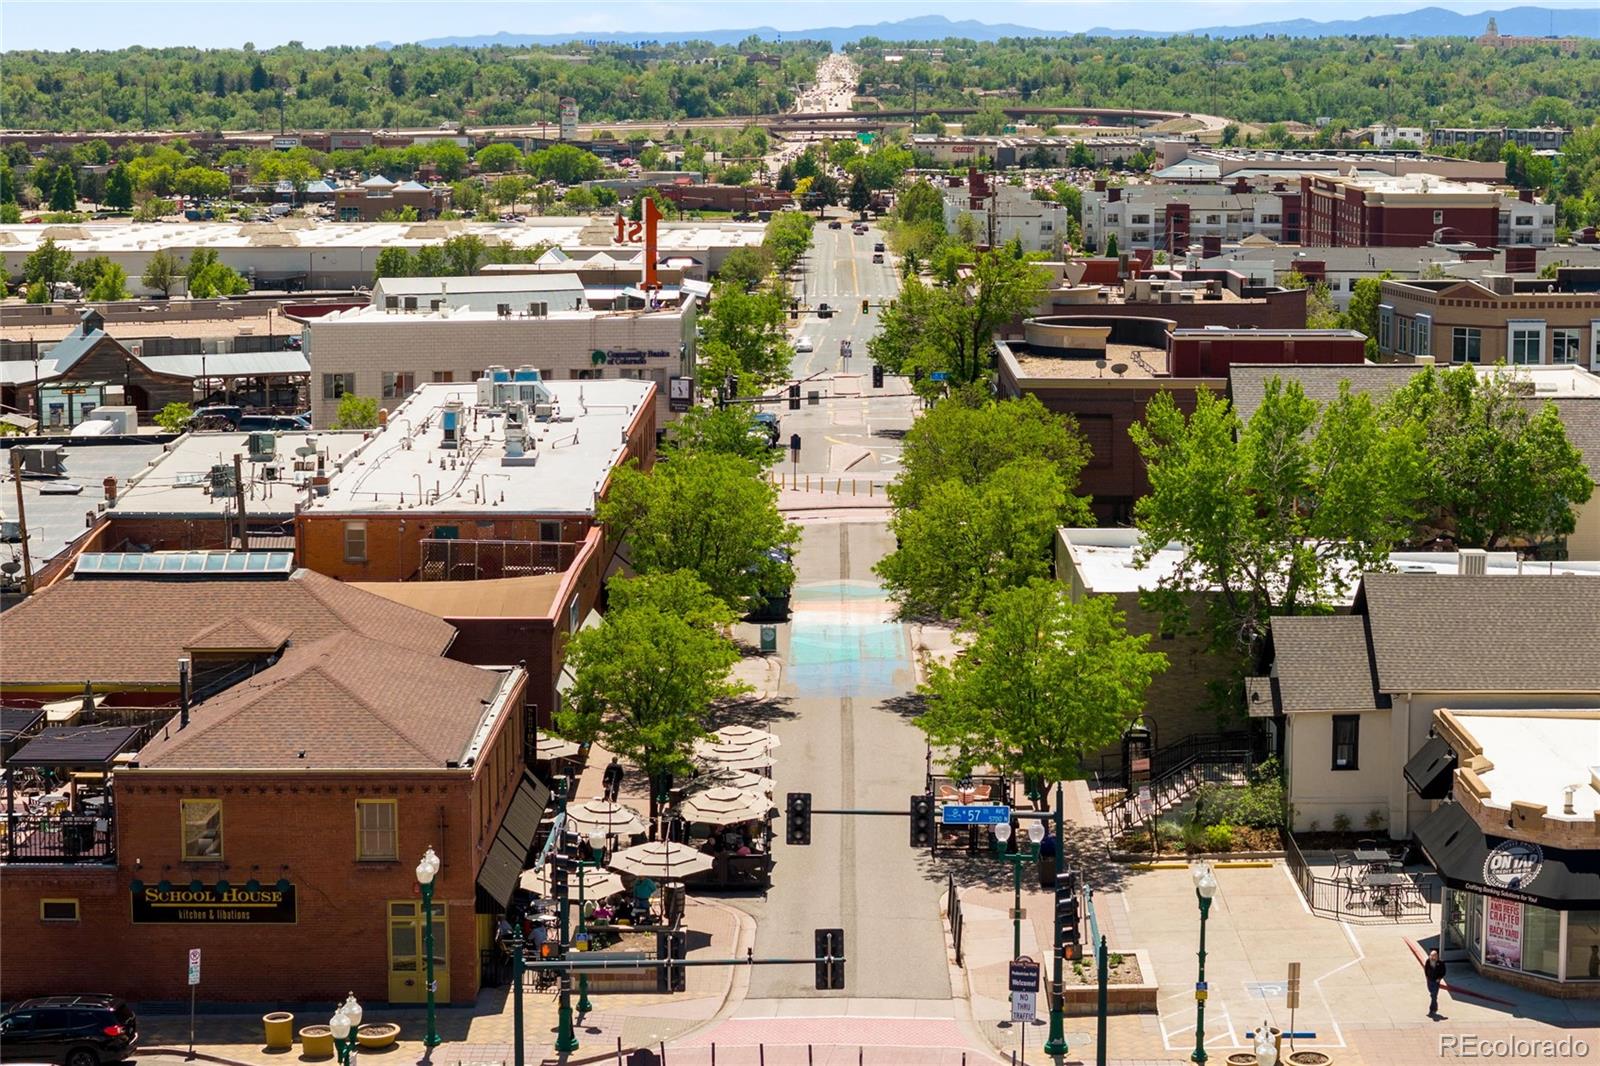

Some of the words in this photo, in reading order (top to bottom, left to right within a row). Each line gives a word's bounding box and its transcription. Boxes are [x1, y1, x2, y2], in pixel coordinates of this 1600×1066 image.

[967, 810, 981, 822] 57
[1490, 855, 1512, 870] ON
[1512, 854, 1538, 869] TAP
[145, 887, 216, 902] SCHOOL
[222, 887, 282, 902] HOUSE
[1465, 883, 1483, 893] Crafting
[1483, 887, 1500, 896] Banking
[1500, 891, 1520, 899] Solutions
[178, 909, 206, 920] kitchen
[208, 910, 215, 920] &
[216, 909, 251, 920] libations
[1491, 902, 1502, 911] AND
[1503, 904, 1519, 915] REFIS
[1490, 911, 1520, 925] CRAFTED
[1489, 925, 1504, 935] BACK
[1505, 929, 1519, 939] YARD
[1012, 979, 1036, 987] Welcome!
[1019, 993, 1029, 1001] NO
[1017, 1002, 1031, 1010] THRU
[1013, 1012, 1034, 1020] TRAFFIC
